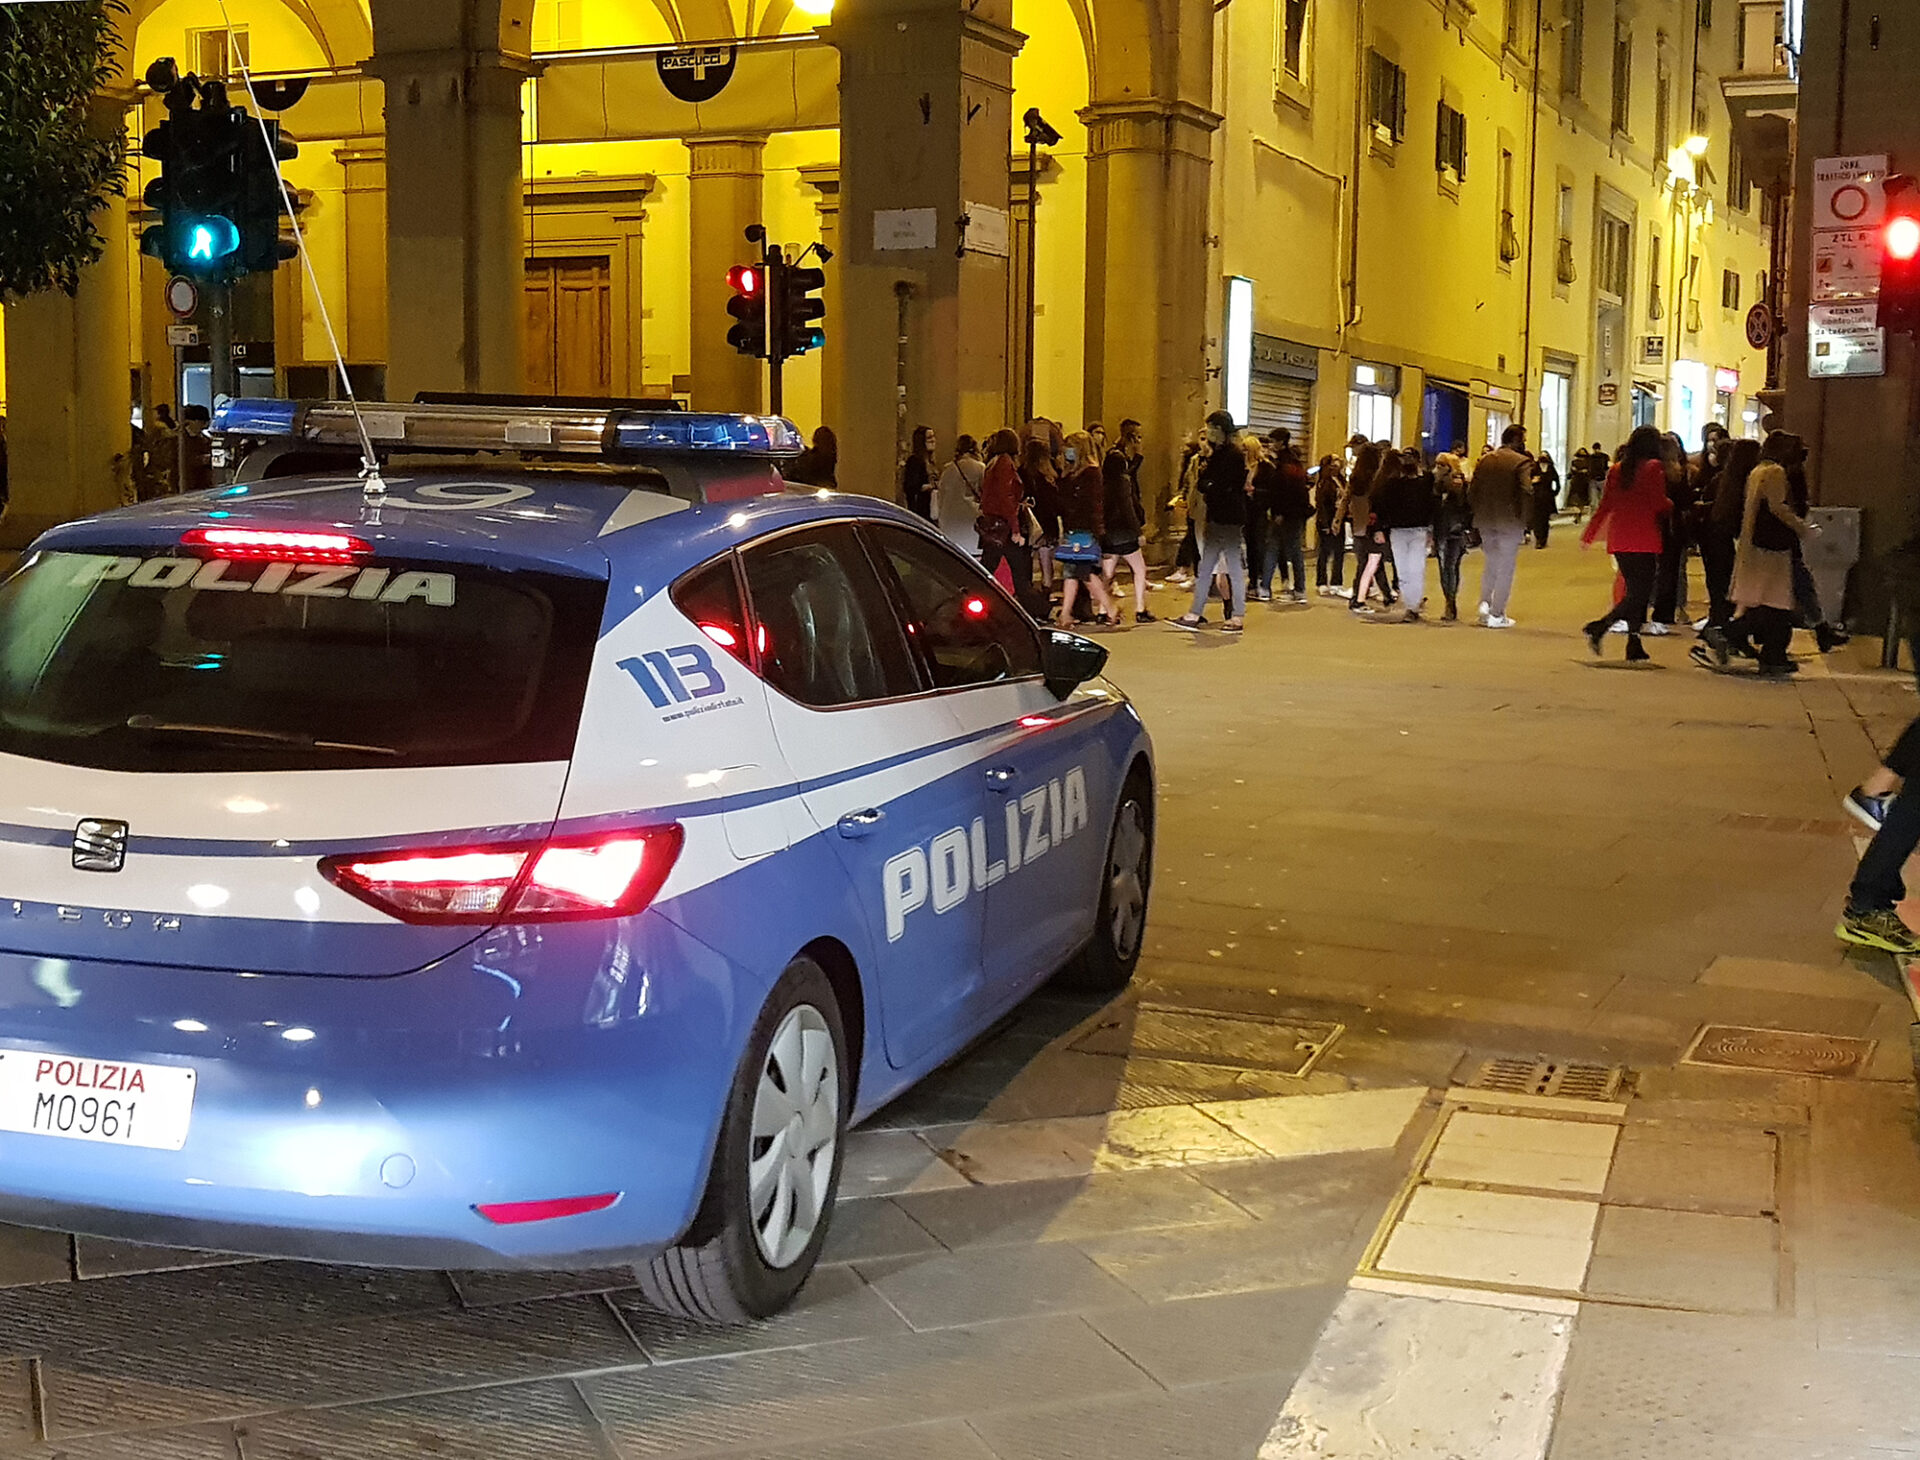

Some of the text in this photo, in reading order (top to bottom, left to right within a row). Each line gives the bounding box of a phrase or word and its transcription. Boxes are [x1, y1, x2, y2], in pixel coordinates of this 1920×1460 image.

[664, 55, 720, 67] PASCUCCI
[68, 556, 456, 607] POLIZIA
[615, 644, 726, 709] 113
[882, 765, 1089, 943] POLIZIA
[36, 1059, 145, 1093] POLIZIA
[33, 1092, 136, 1138] M0961
